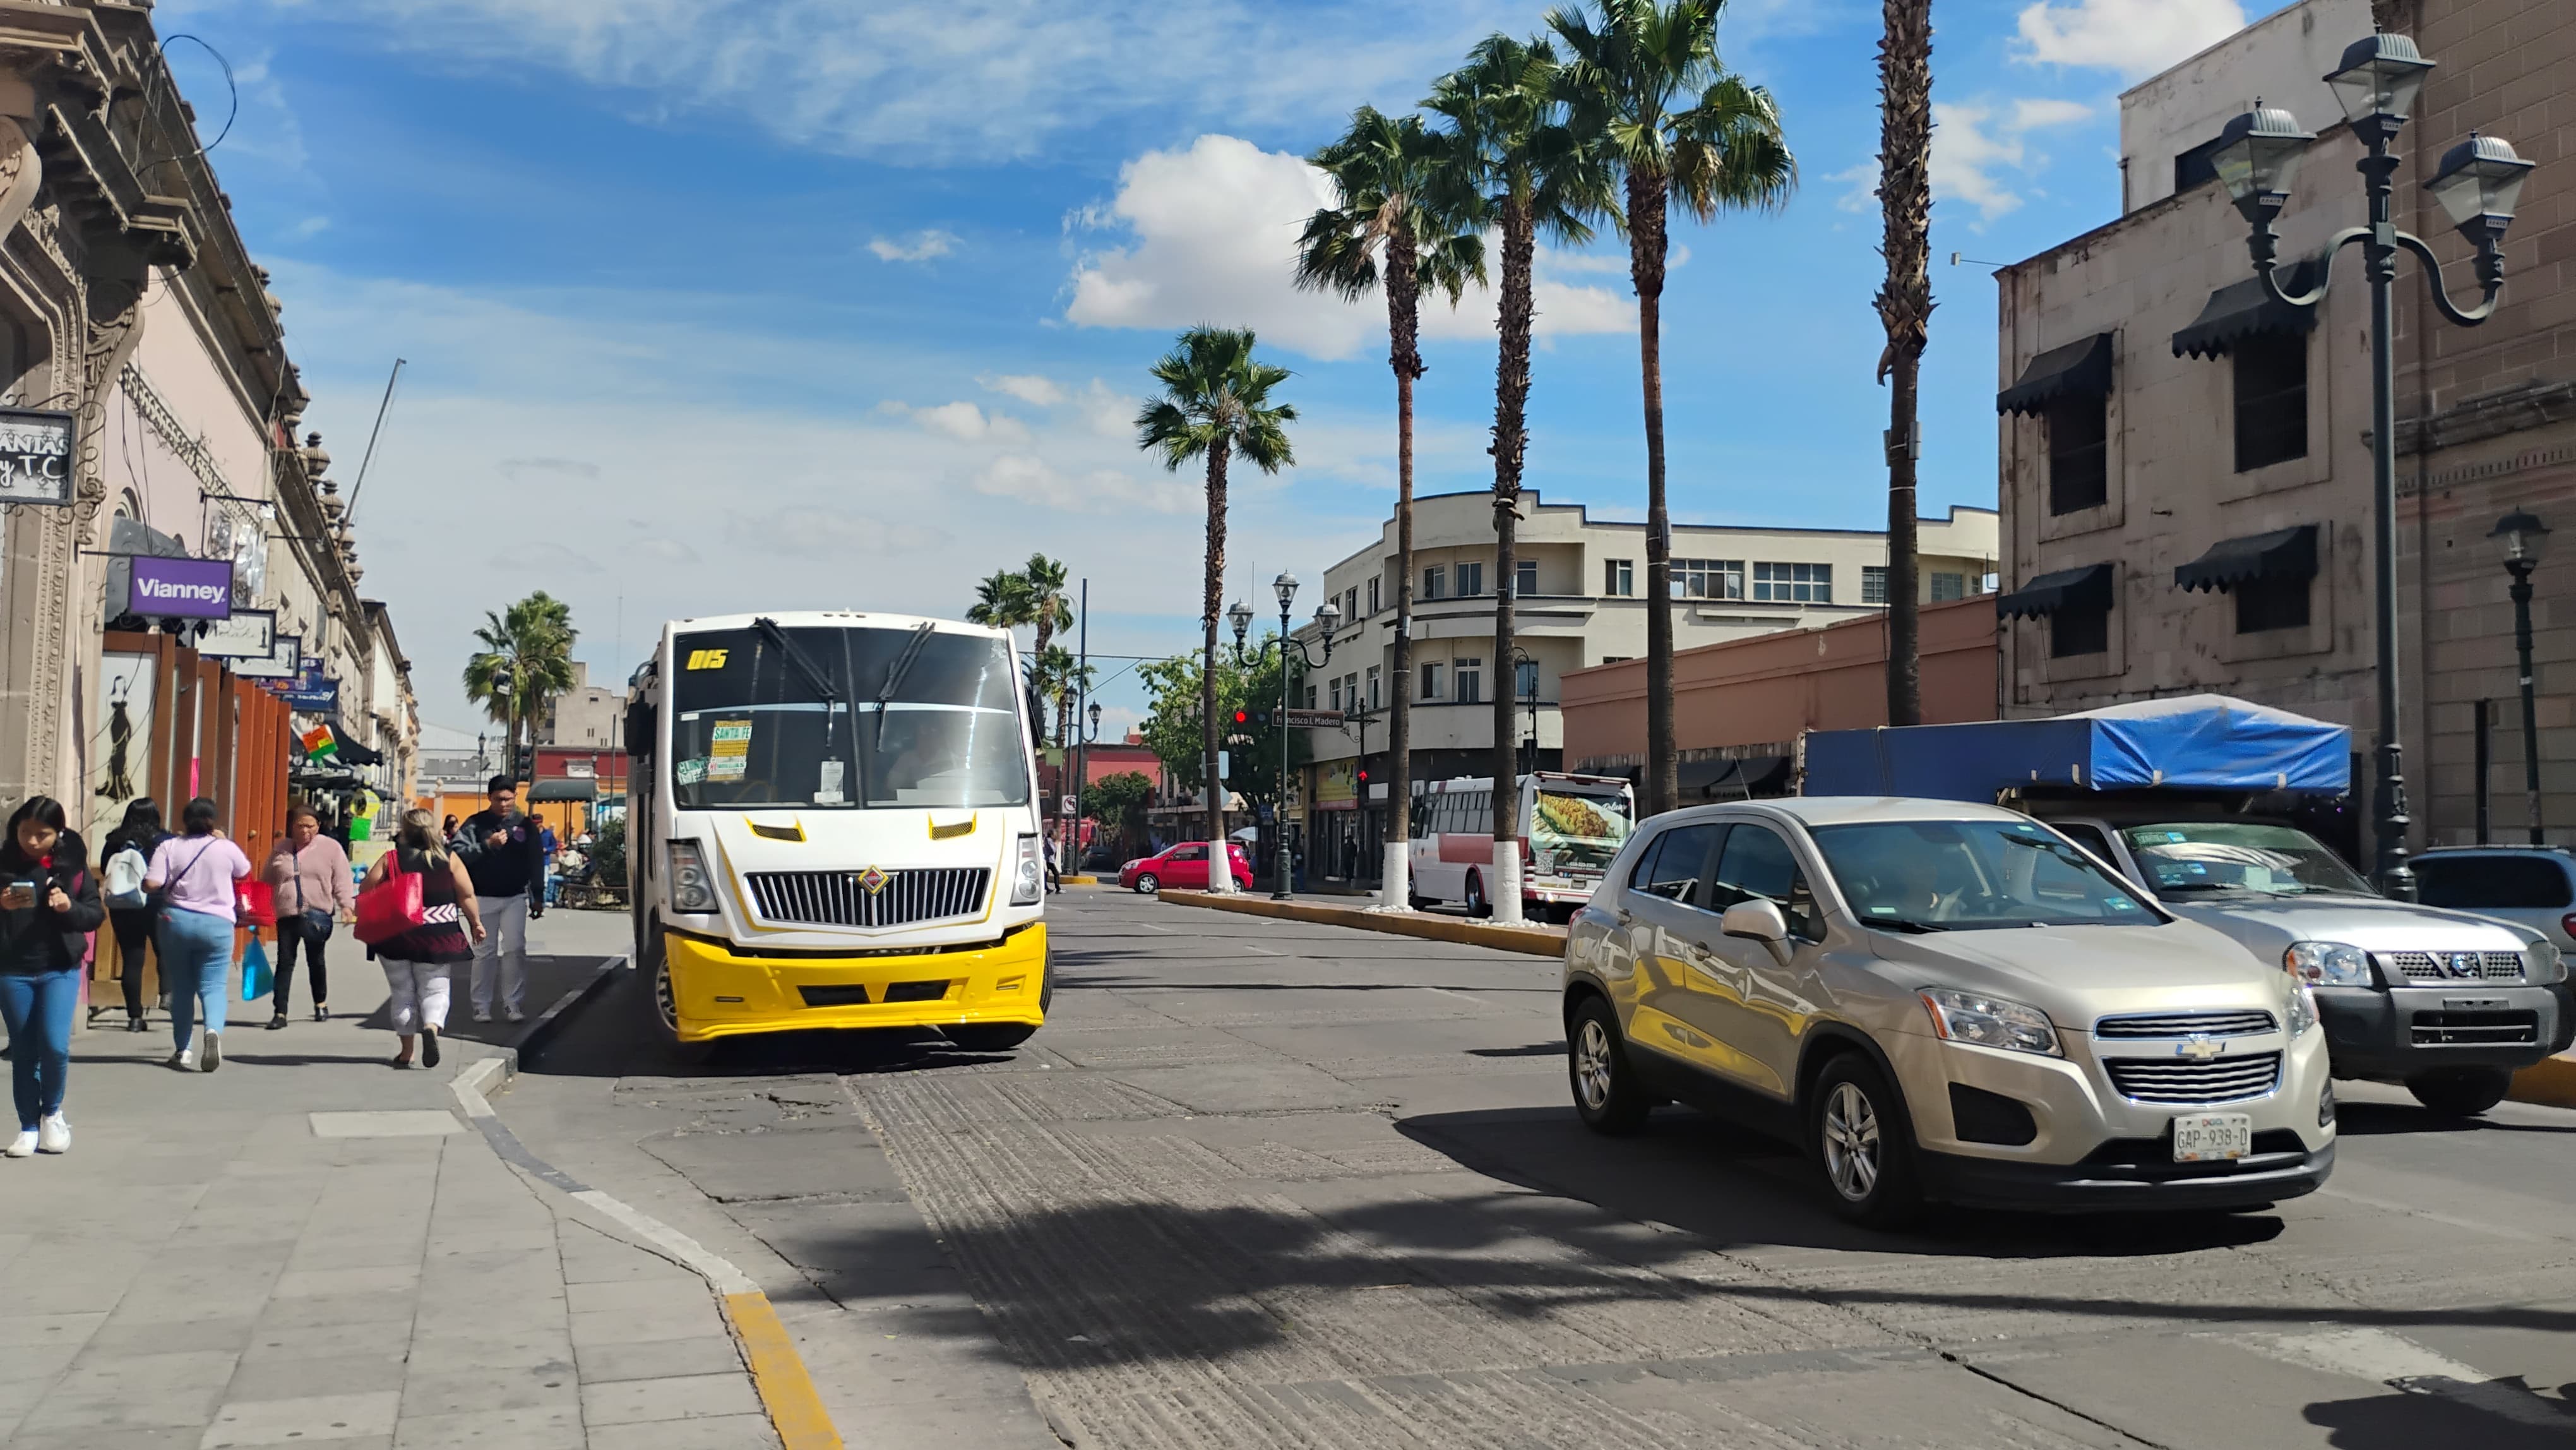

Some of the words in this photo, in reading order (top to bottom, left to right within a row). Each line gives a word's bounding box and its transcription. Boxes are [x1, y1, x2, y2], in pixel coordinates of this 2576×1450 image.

[1276, 715, 1308, 724] Frncisco
[1315, 717, 1340, 726] Madero
[715, 727, 739, 740] SANTA
[742, 727, 750, 738] FE
[2178, 1127, 2248, 1149] GAP-938-D
